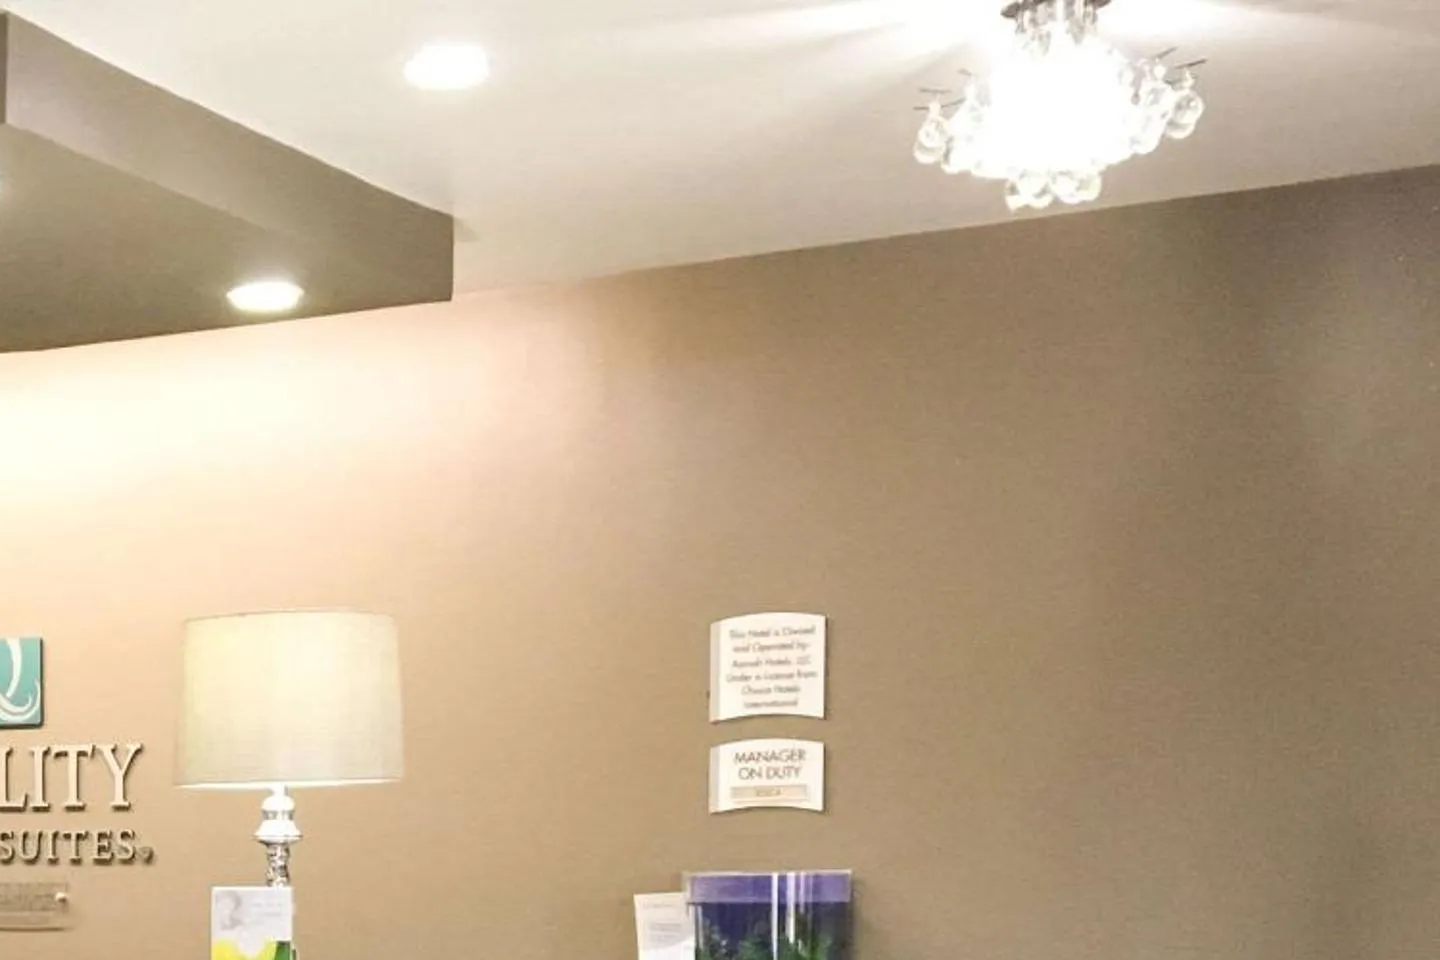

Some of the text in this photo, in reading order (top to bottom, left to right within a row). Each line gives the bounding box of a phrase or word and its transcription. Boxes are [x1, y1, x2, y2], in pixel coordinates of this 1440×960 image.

[733, 747, 807, 765] MANAGER
[738, 764, 803, 781] ON DUTY
